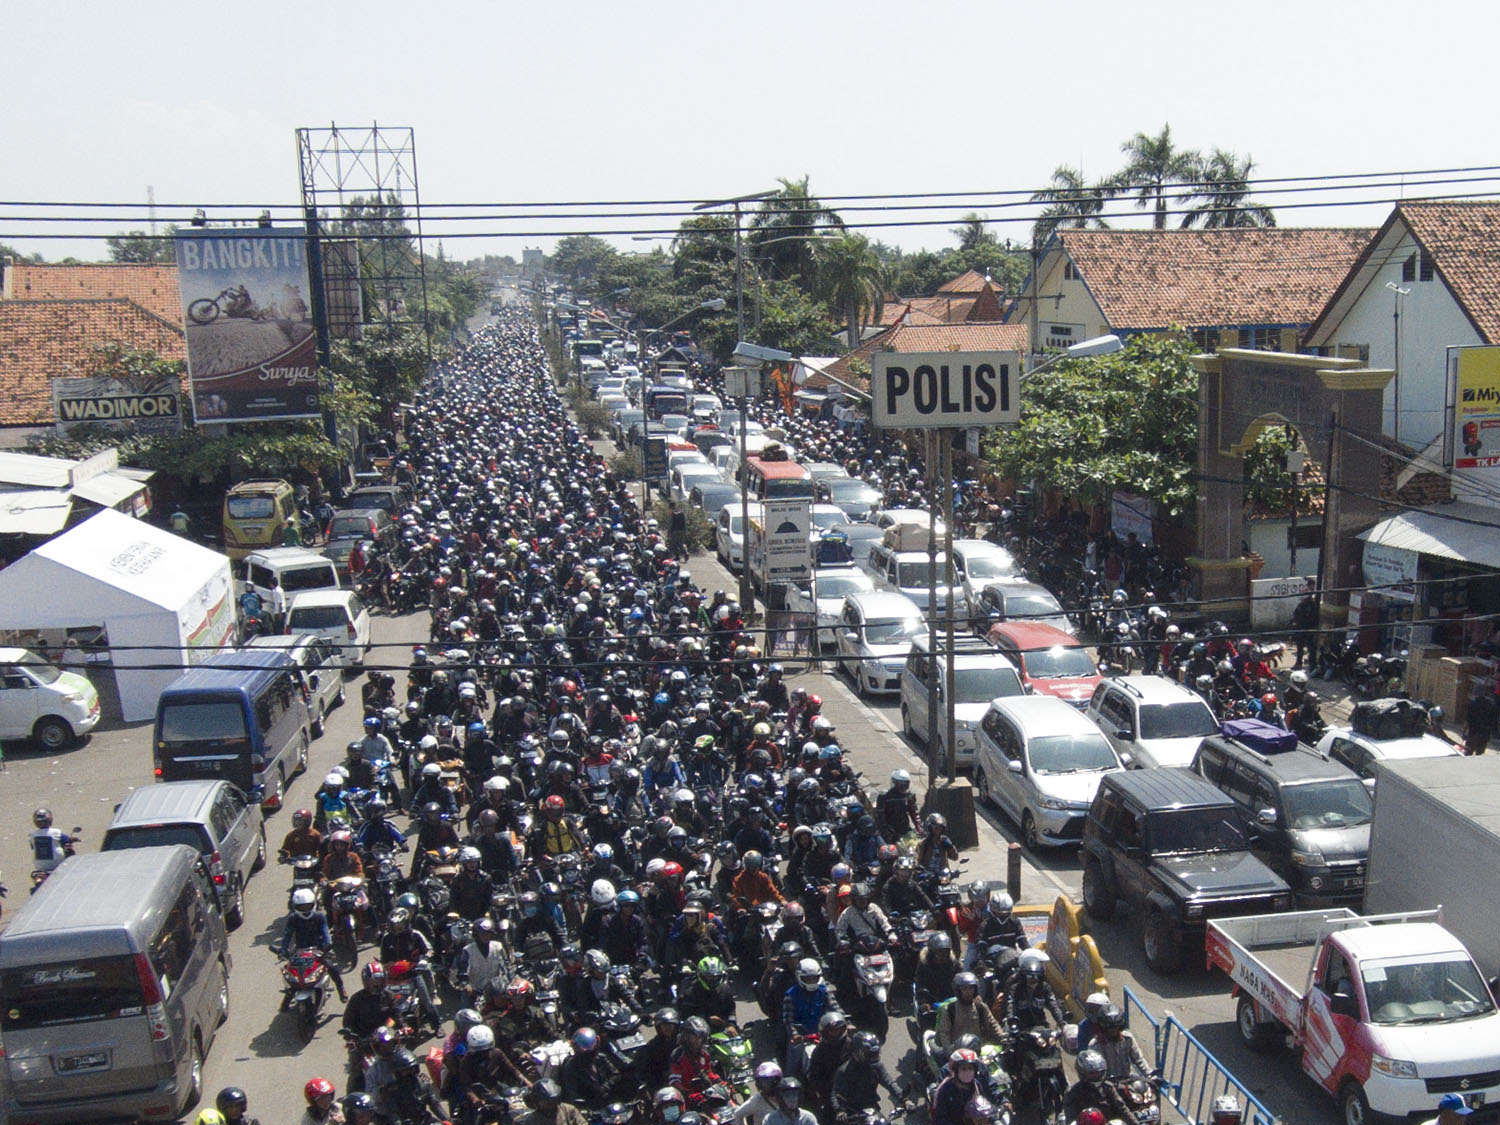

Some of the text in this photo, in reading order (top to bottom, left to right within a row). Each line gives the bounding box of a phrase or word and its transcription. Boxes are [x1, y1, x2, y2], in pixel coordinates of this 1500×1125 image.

[182, 239, 300, 270] BANGKIT!
[258, 362, 316, 386] Surya
[886, 363, 1010, 415] POLISI
[62, 397, 172, 419] WADIMOR
[1476, 458, 1489, 467] TK
[1240, 963, 1259, 992] NAGA
